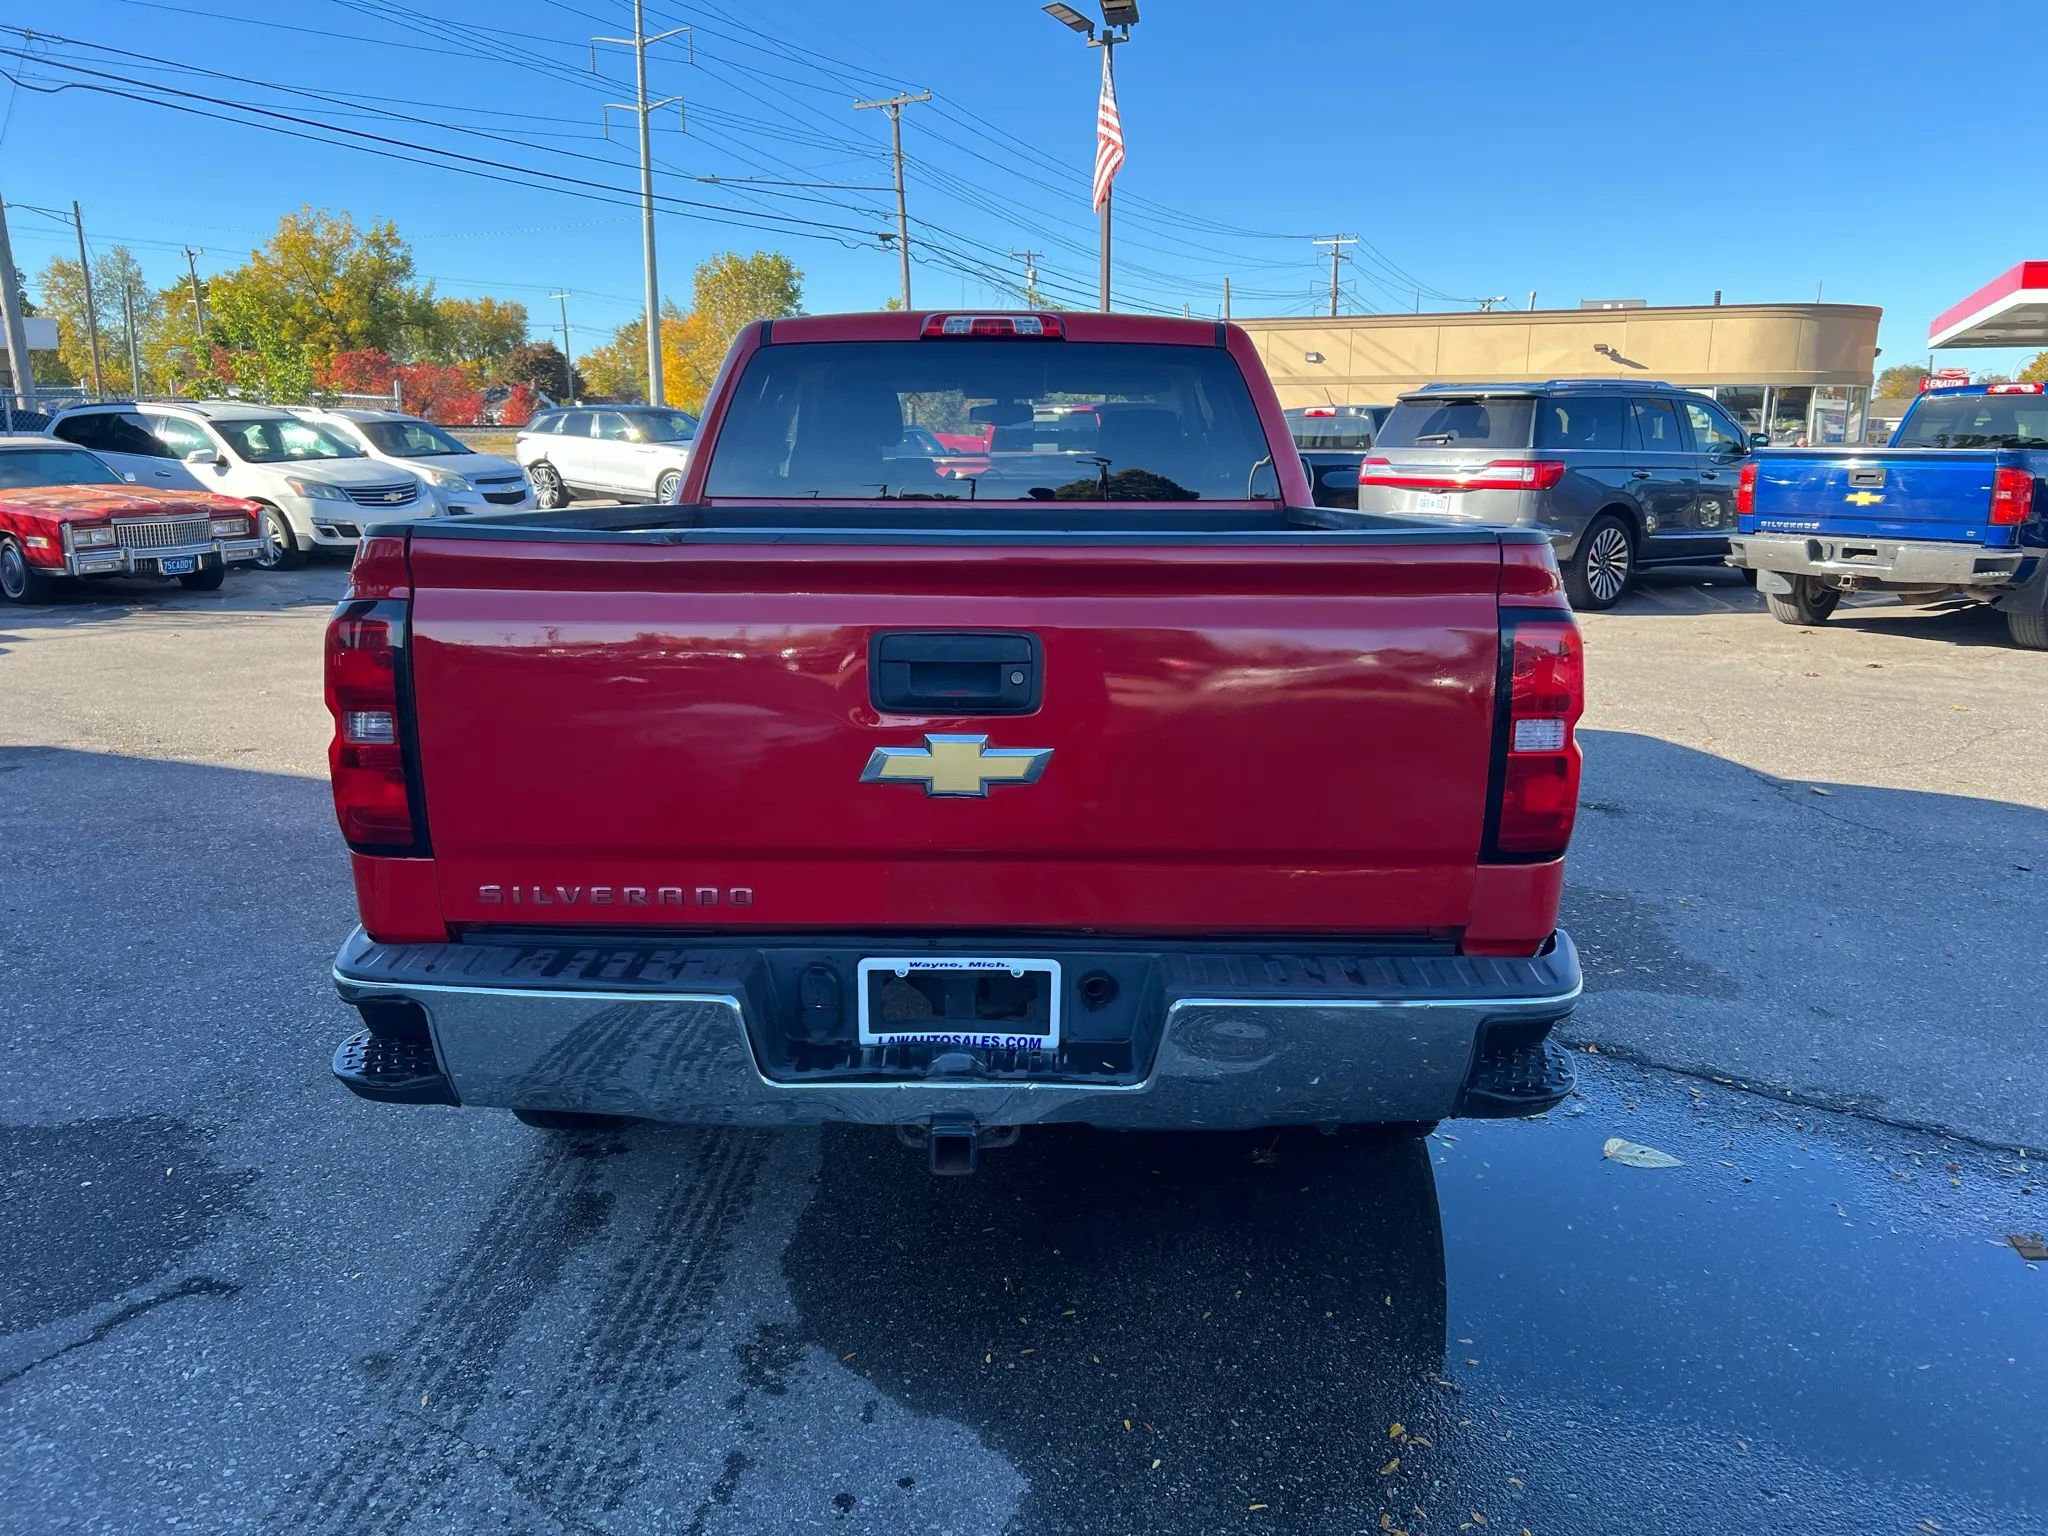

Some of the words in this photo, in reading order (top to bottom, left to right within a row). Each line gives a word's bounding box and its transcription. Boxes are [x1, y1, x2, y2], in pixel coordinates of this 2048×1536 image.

[163, 559, 192, 570] 75CADDY
[479, 884, 754, 906] SILVERADO
[878, 1035, 1042, 1049] LAWAUTOSALES.COM
